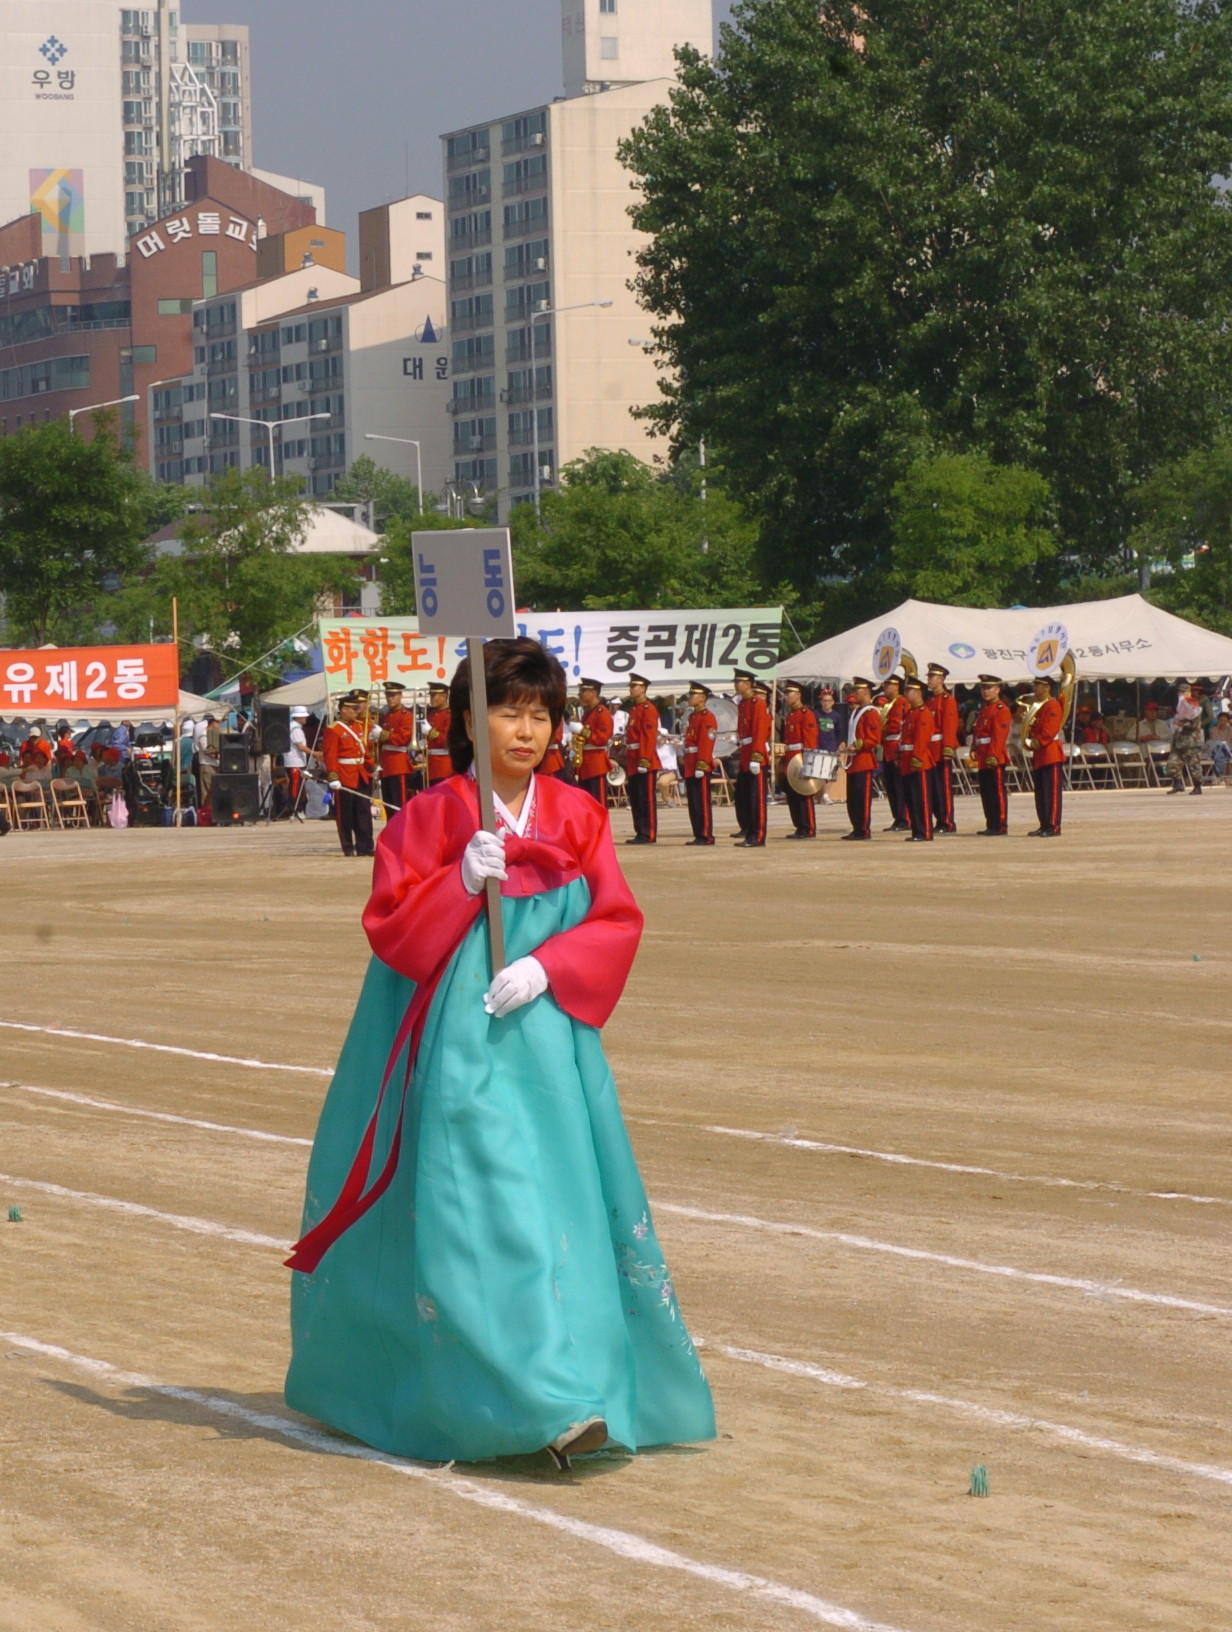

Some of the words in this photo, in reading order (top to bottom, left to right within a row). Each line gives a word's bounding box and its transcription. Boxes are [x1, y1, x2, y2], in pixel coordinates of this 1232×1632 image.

[31, 69, 76, 90] 우방
[323, 626, 446, 684] 화합도!
[606, 623, 781, 672] 중곡제2동
